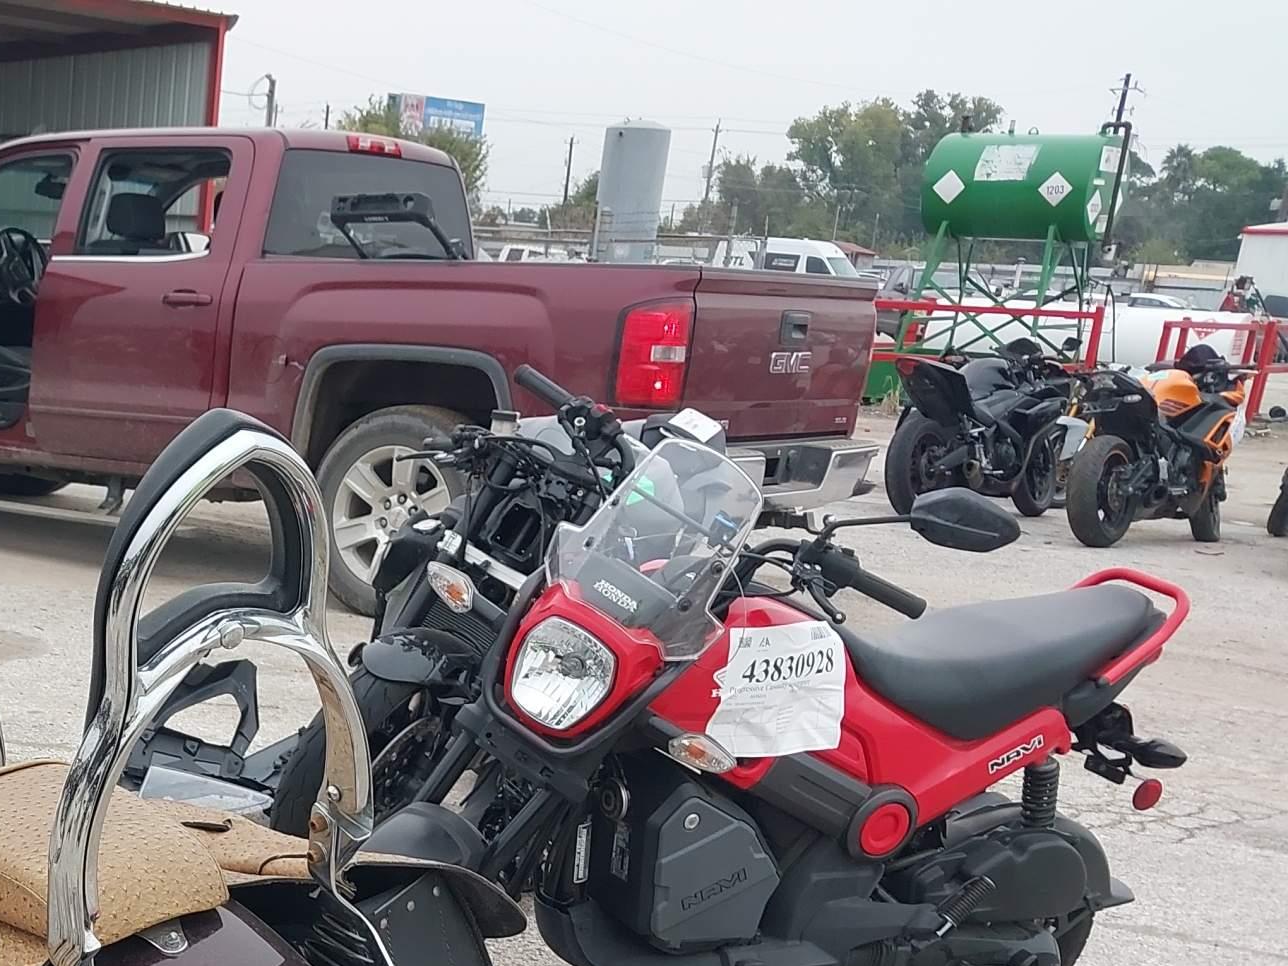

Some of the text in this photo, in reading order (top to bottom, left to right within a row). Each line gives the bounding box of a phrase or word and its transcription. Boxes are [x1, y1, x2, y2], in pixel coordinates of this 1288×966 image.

[1047, 185, 1065, 196] 1203
[770, 351, 812, 373] GMC
[598, 579, 638, 609] HONDA
[742, 647, 834, 684] 43830928
[988, 734, 1044, 775] NAVI
[681, 867, 747, 911] NAVI
